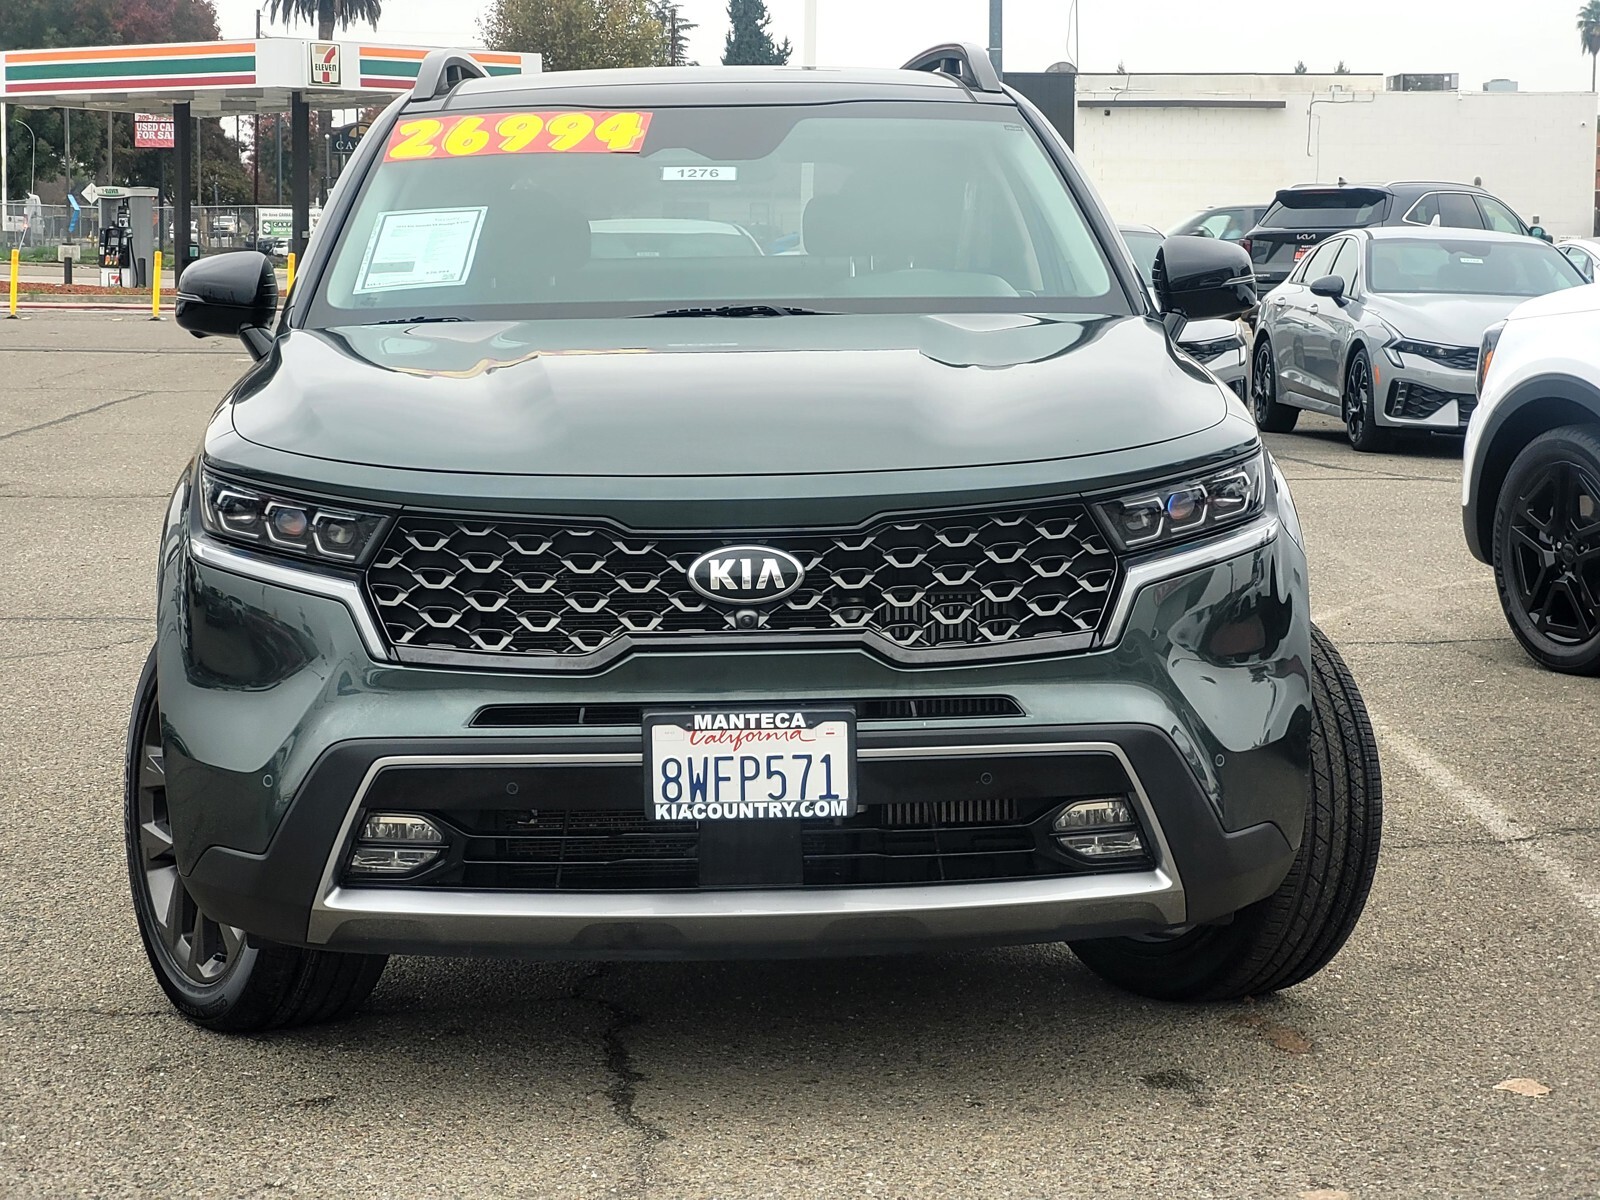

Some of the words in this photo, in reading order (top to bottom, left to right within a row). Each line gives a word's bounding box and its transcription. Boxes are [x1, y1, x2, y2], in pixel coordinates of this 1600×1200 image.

[136, 122, 158, 131] USED
[137, 131, 156, 139] FOR
[388, 112, 645, 159] 26994
[677, 168, 719, 178] 1276
[708, 558, 786, 590] KIA
[693, 713, 807, 730] MANTECA
[689, 729, 817, 752] California
[661, 753, 840, 803] 8WFP571
[655, 800, 848, 820] KIACOUNTRY.COM
